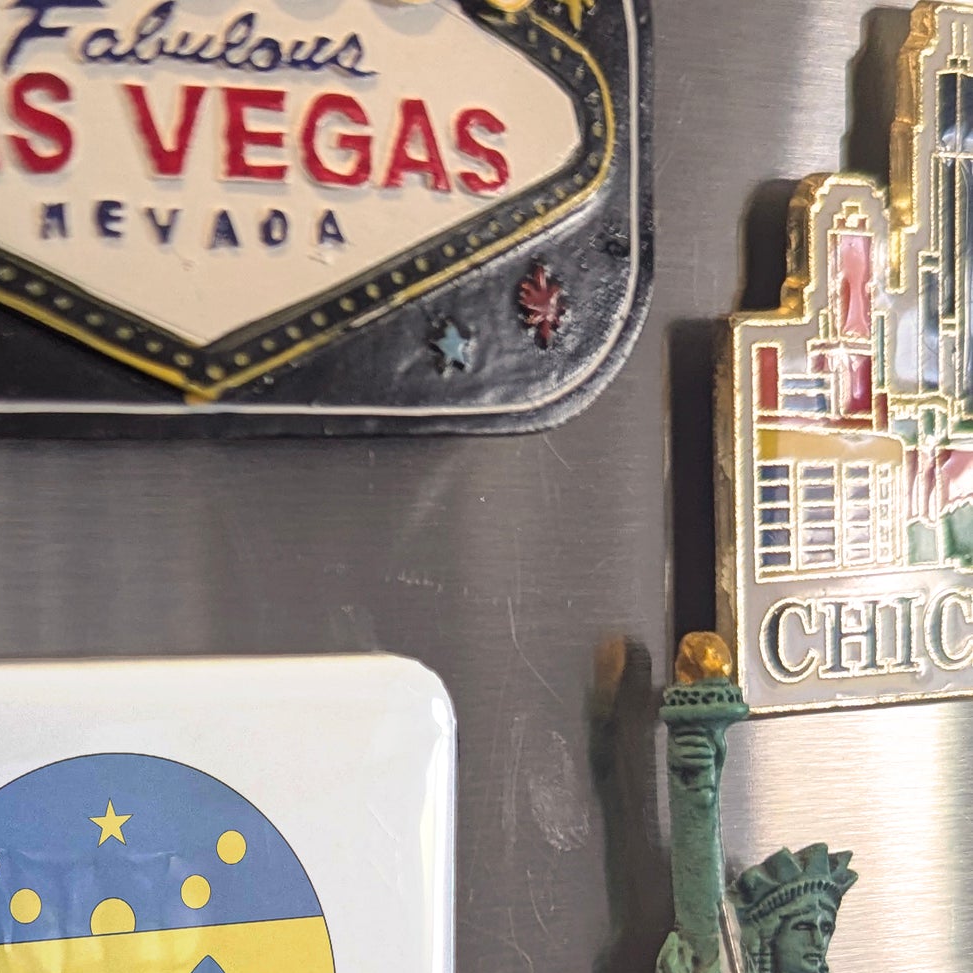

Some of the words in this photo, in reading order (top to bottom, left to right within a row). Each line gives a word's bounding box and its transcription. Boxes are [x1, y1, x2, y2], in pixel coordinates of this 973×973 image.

[0, 0, 378, 77] Fabulous
[123, 83, 509, 193] VEGAS
[39, 200, 346, 249] NEVADA
[759, 588, 973, 684] CHIC
